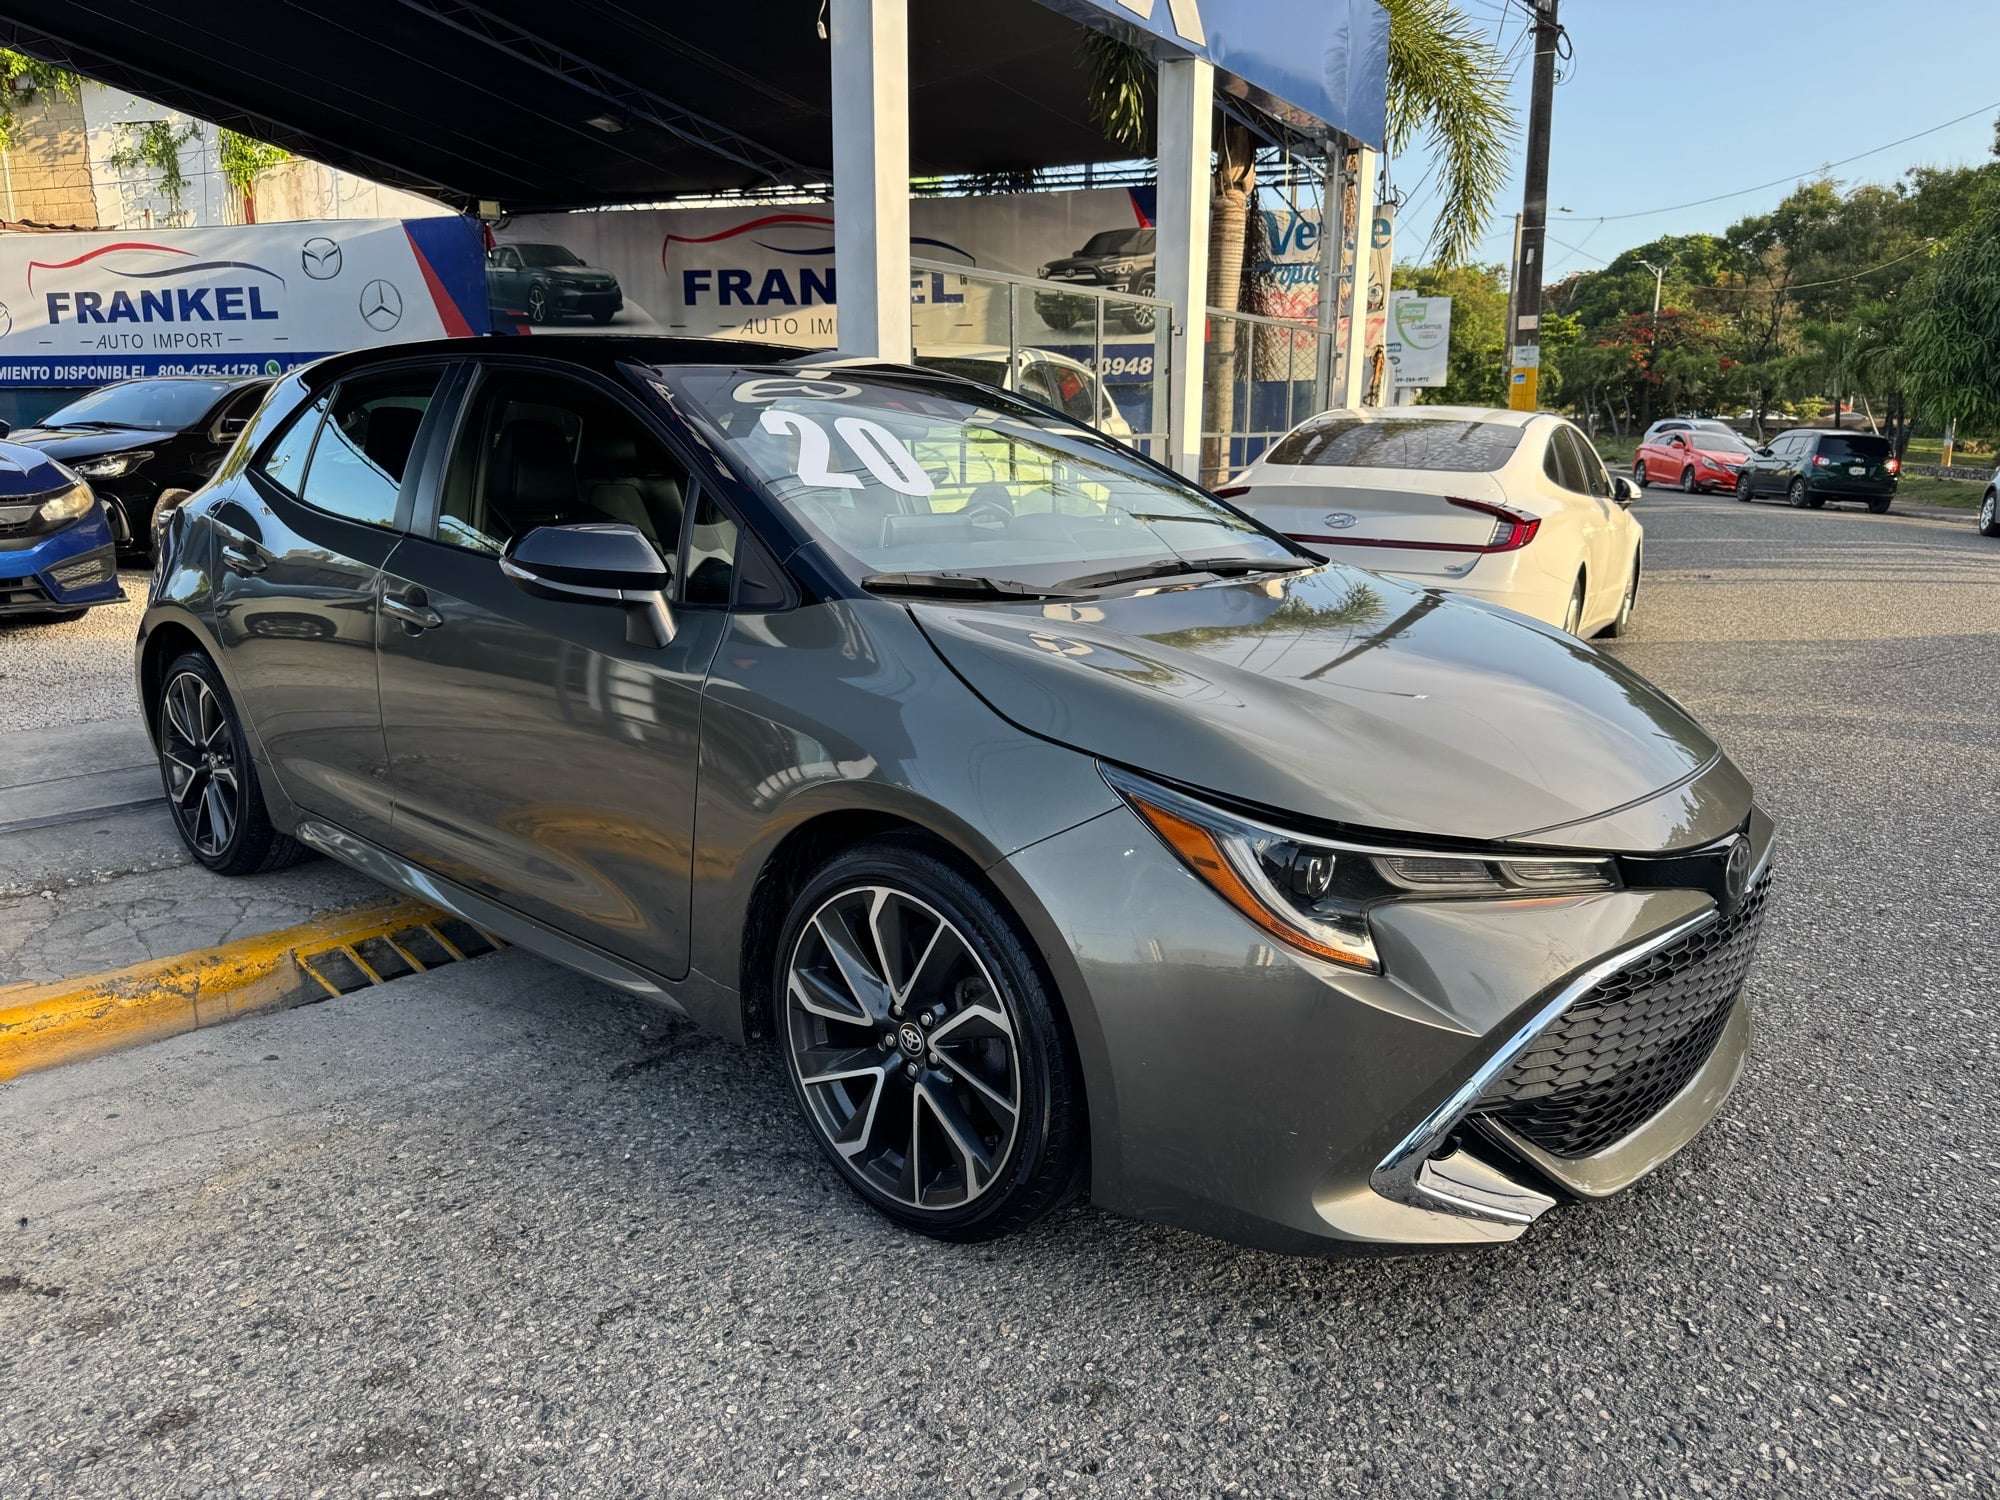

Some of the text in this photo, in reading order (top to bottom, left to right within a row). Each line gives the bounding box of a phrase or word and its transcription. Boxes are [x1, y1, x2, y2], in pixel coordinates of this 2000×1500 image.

[46, 287, 279, 324] FRANKEL
[740, 318, 798, 335] AUTO
[96, 332, 223, 350] AUTO IMPORT
[158, 364, 258, 376] 809-475-1178
[760, 410, 935, 497] 20
